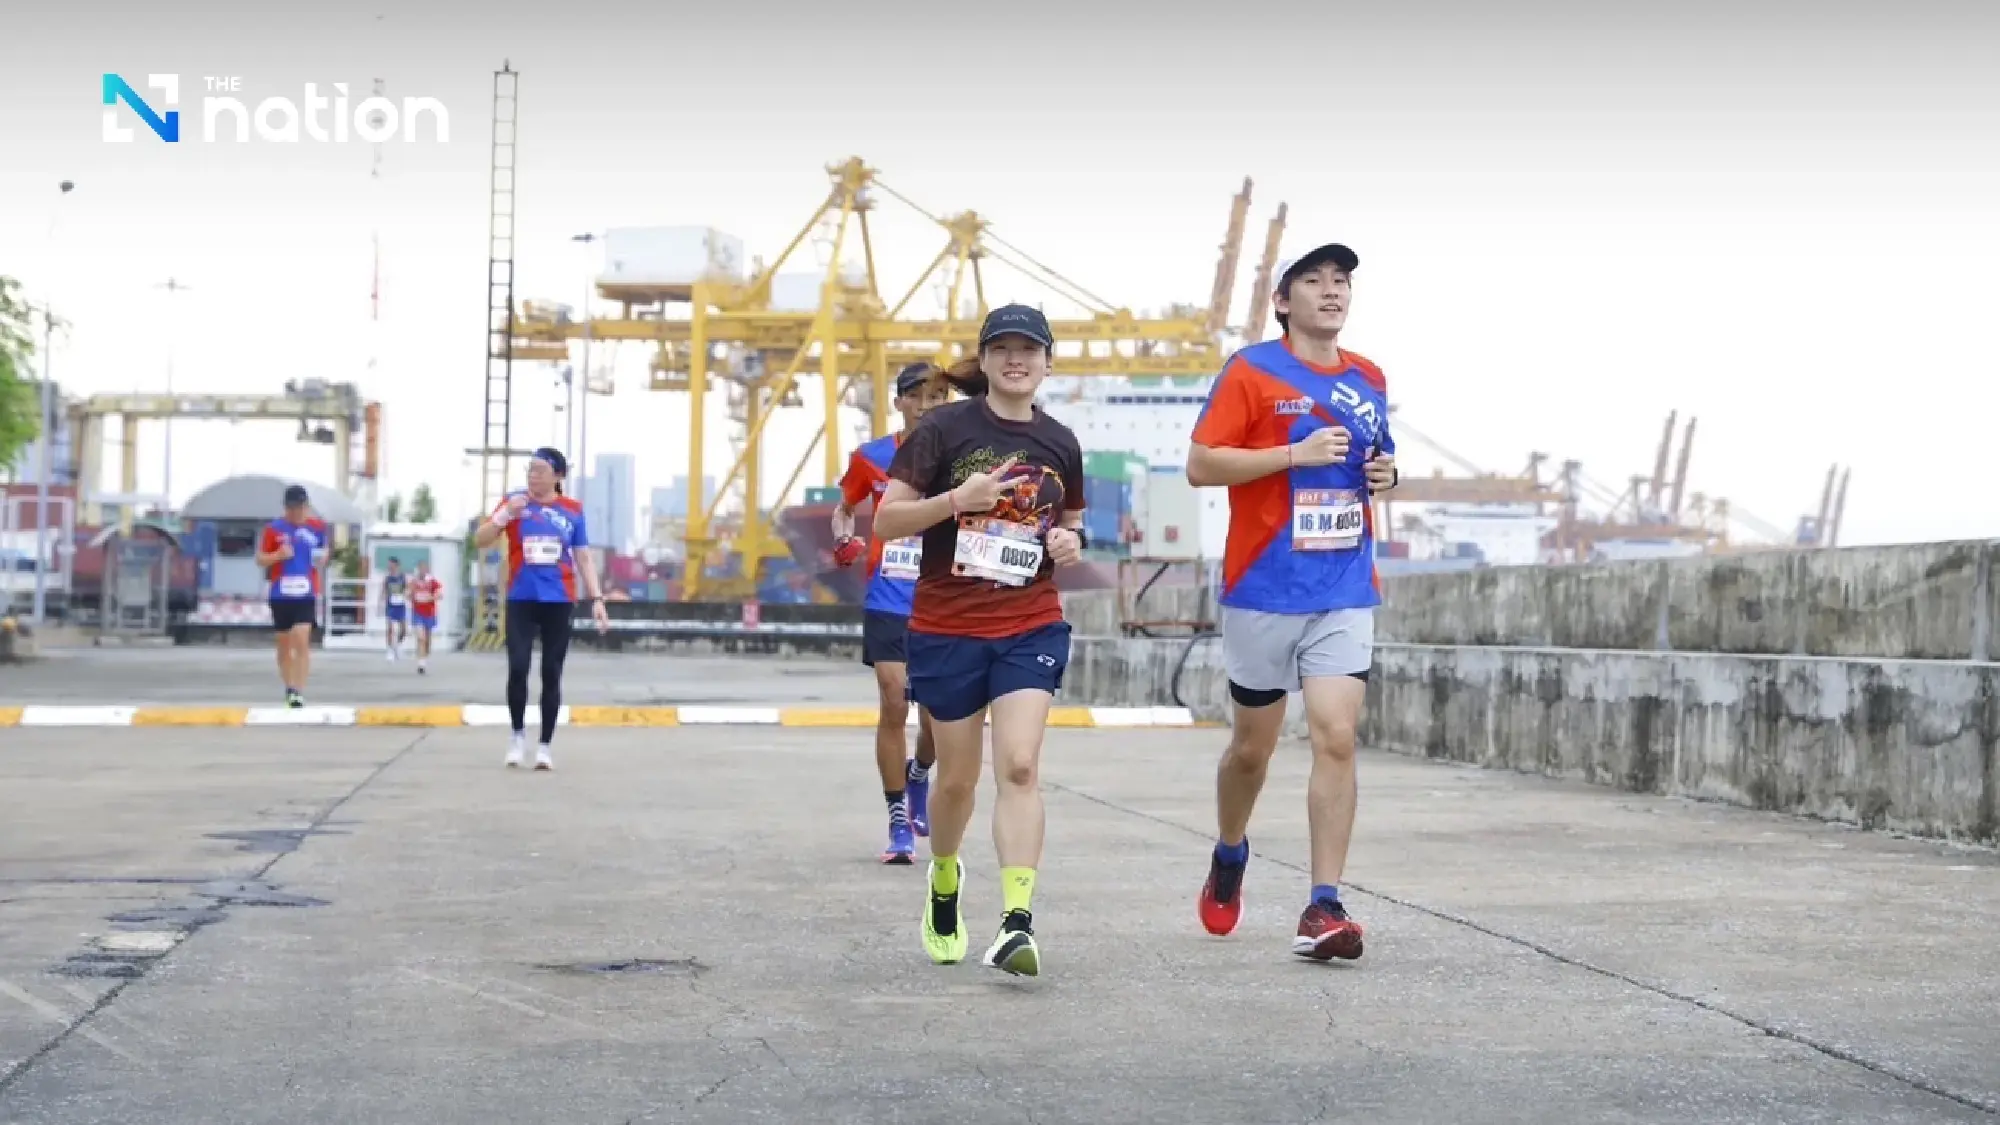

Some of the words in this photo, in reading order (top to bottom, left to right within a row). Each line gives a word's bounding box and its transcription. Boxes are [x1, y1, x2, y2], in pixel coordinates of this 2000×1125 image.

[1299, 513, 1313, 530] 16
[1318, 513, 1333, 530] M
[999, 545, 1038, 570] 0802
